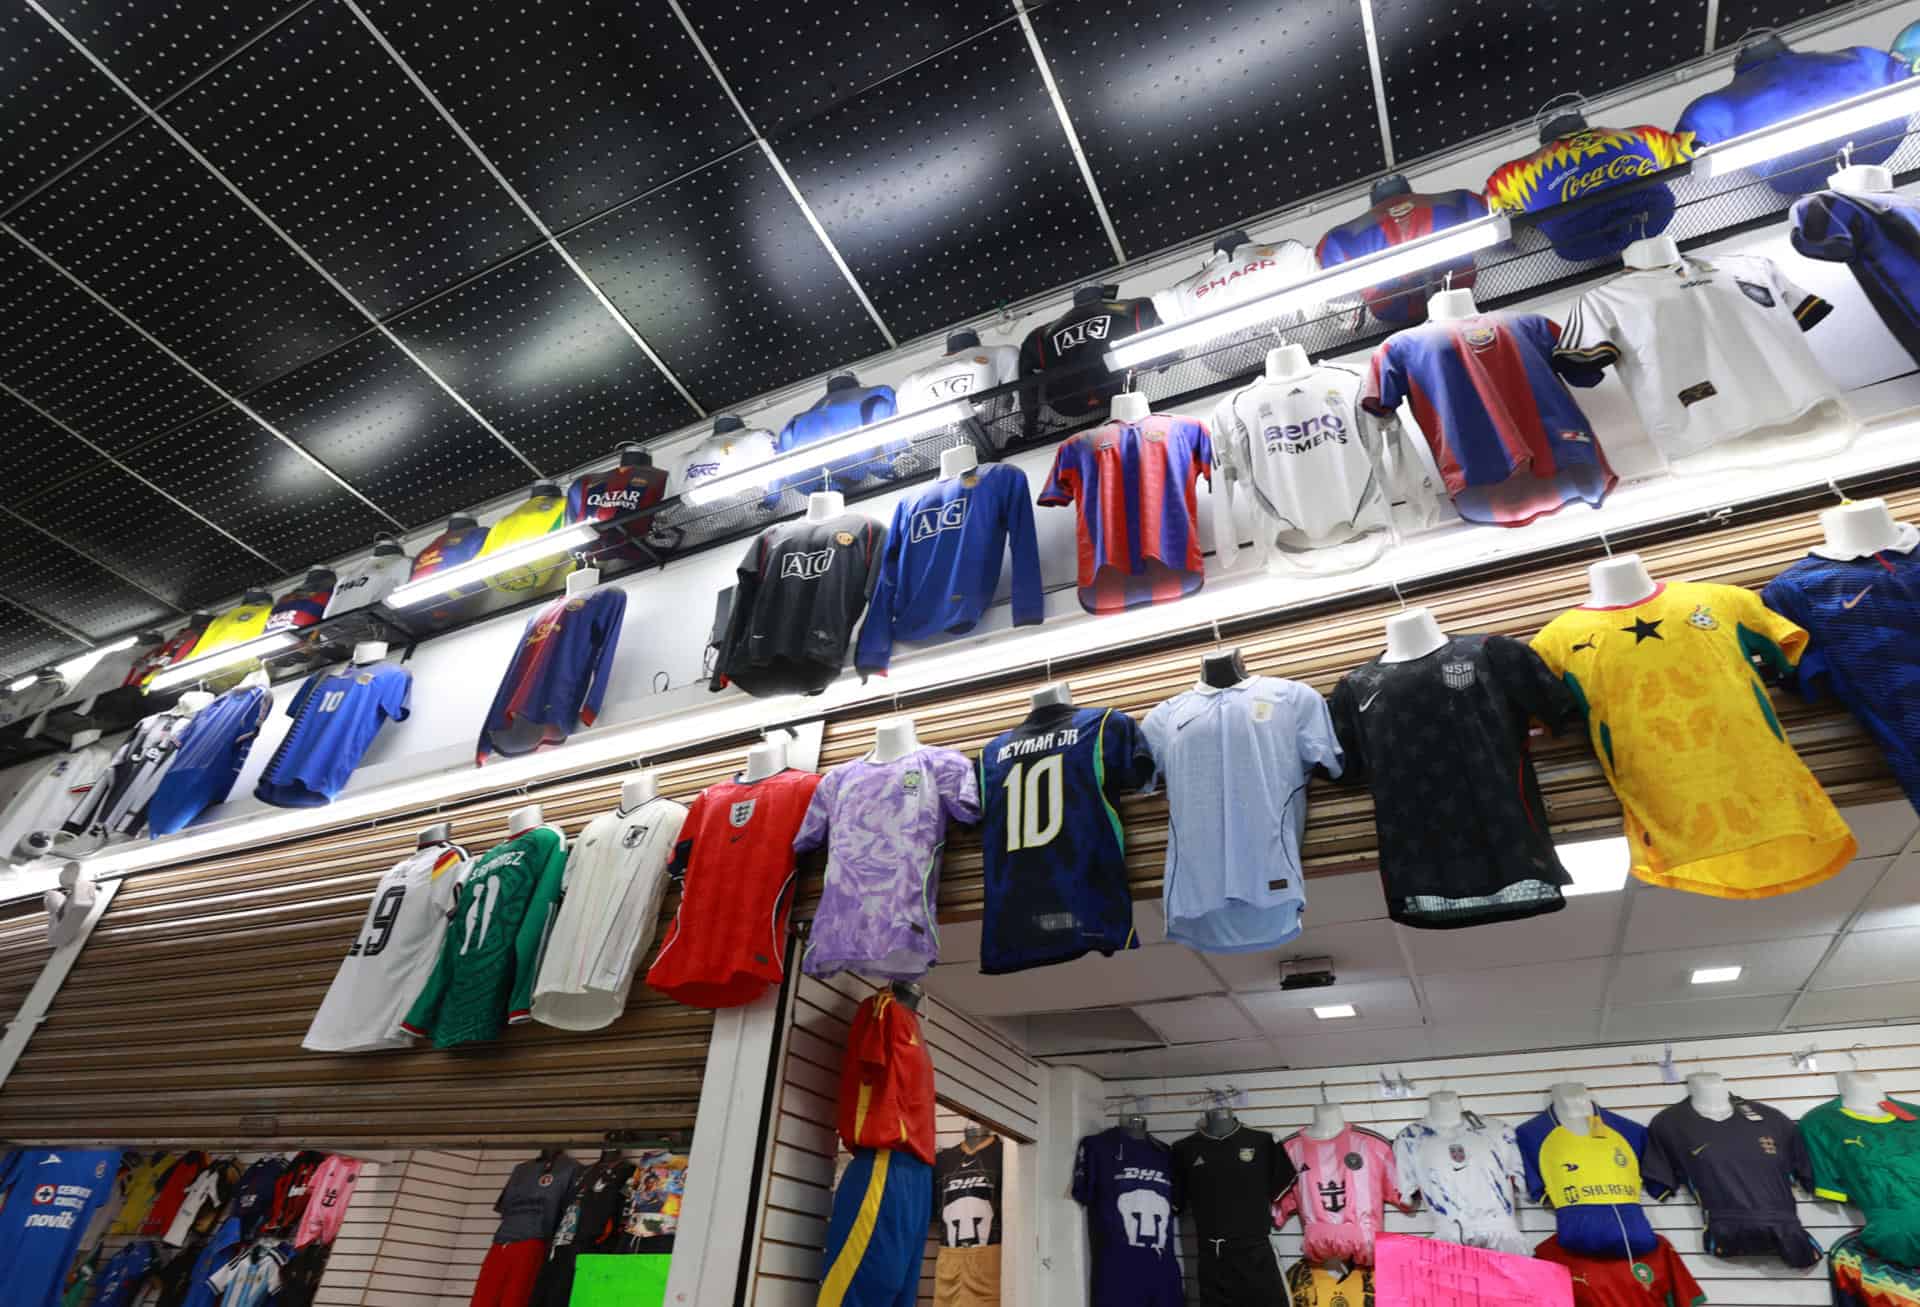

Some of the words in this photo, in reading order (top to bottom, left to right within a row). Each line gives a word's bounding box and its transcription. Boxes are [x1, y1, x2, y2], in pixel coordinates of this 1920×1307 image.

[1196, 259, 1277, 298] SHARP
[1060, 317, 1106, 350] AIG
[1267, 428, 1348, 456] SIEMENS
[587, 489, 641, 506] QATAR
[913, 502, 963, 540] AIG
[318, 690, 345, 713] 10
[996, 732, 1055, 764] NEYMAR
[1057, 728, 1079, 747] JR
[1002, 753, 1064, 853] 10
[460, 875, 500, 956] 11
[946, 1176, 990, 1191] DHL
[1119, 1168, 1168, 1184] DHL
